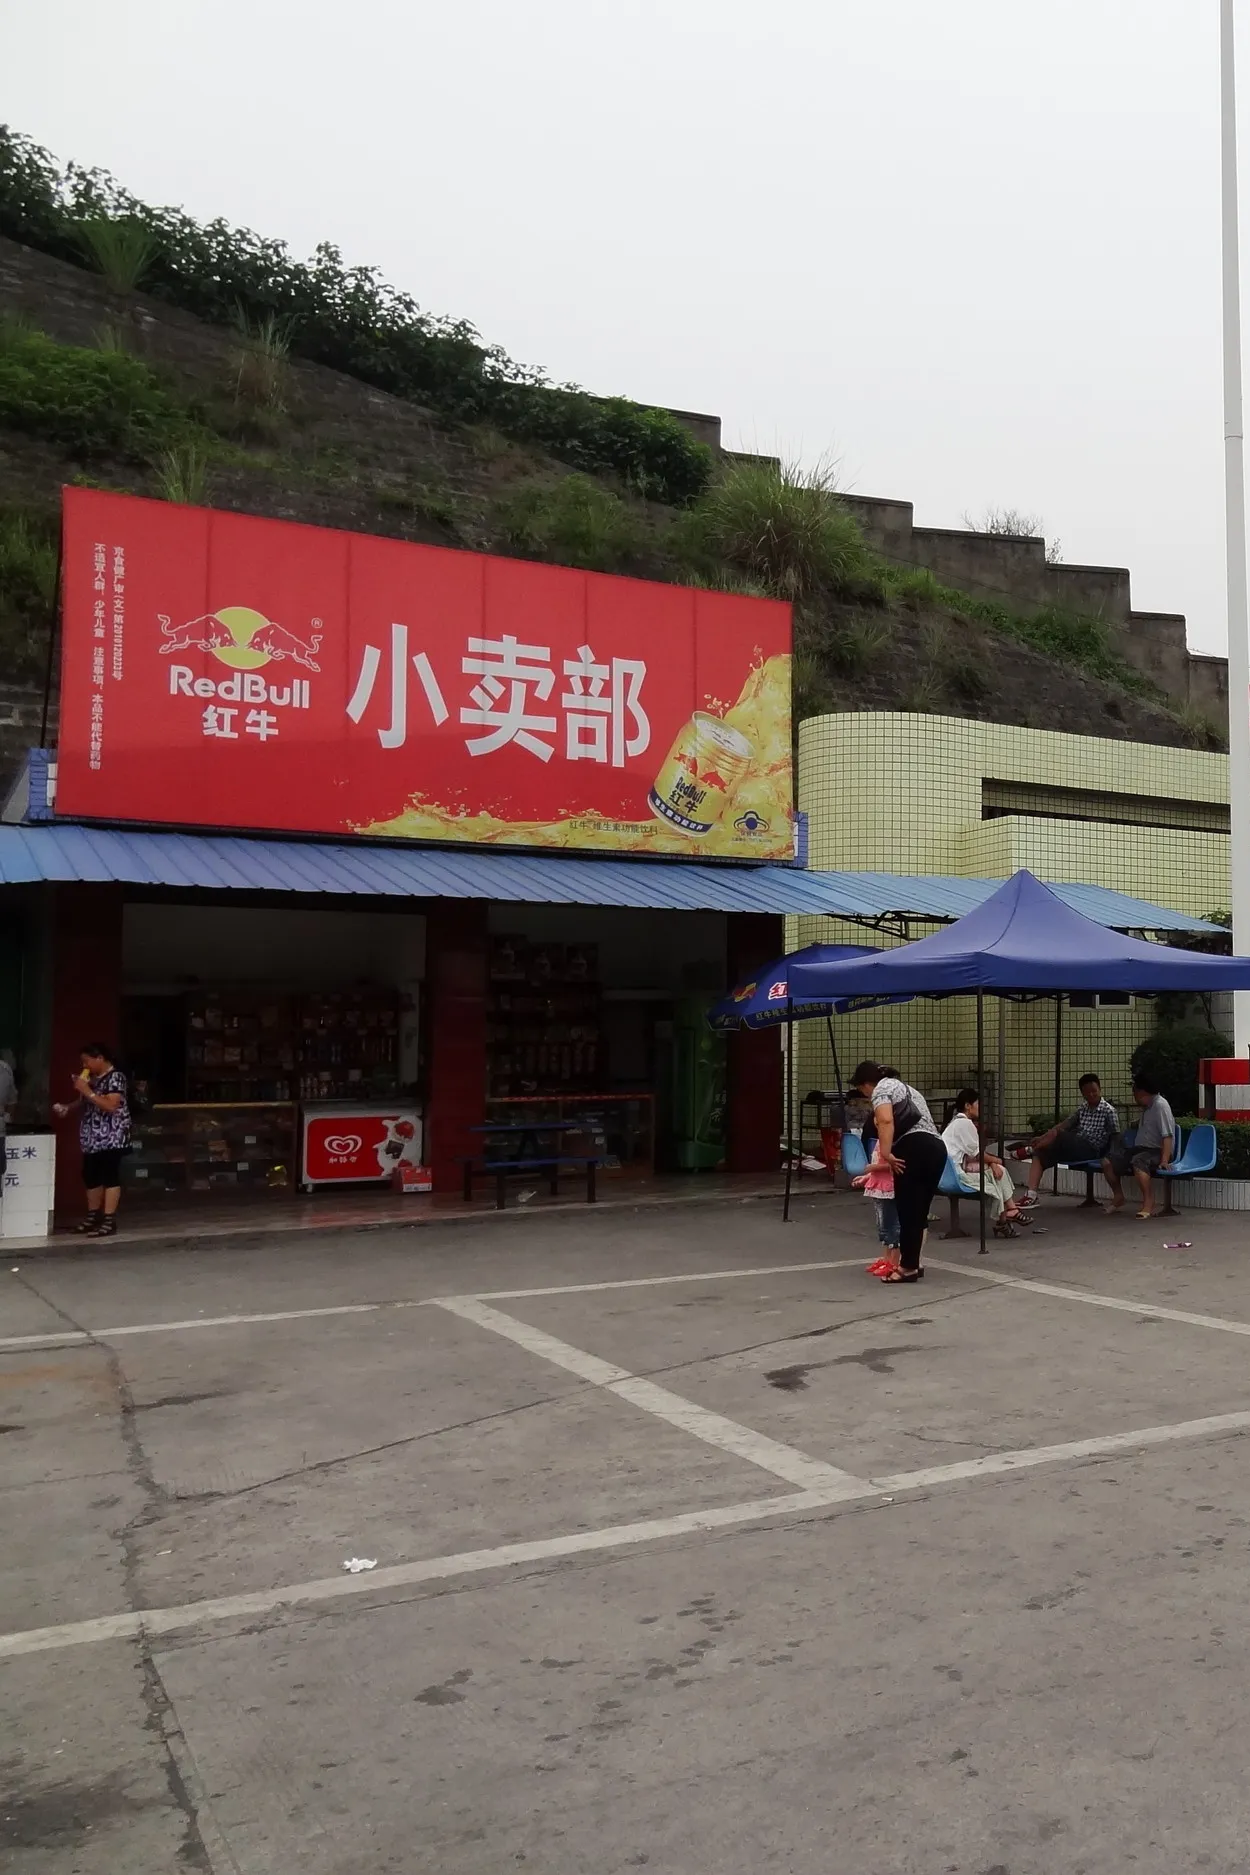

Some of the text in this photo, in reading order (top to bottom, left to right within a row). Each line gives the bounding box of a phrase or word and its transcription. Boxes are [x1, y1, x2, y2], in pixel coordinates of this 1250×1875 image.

[169, 664, 310, 709] RedBull
[345, 622, 651, 768] 小卖部
[202, 704, 279, 742] 红牛
[668, 789, 699, 813] 红牛
[5, 1146, 38, 1160] 玉米
